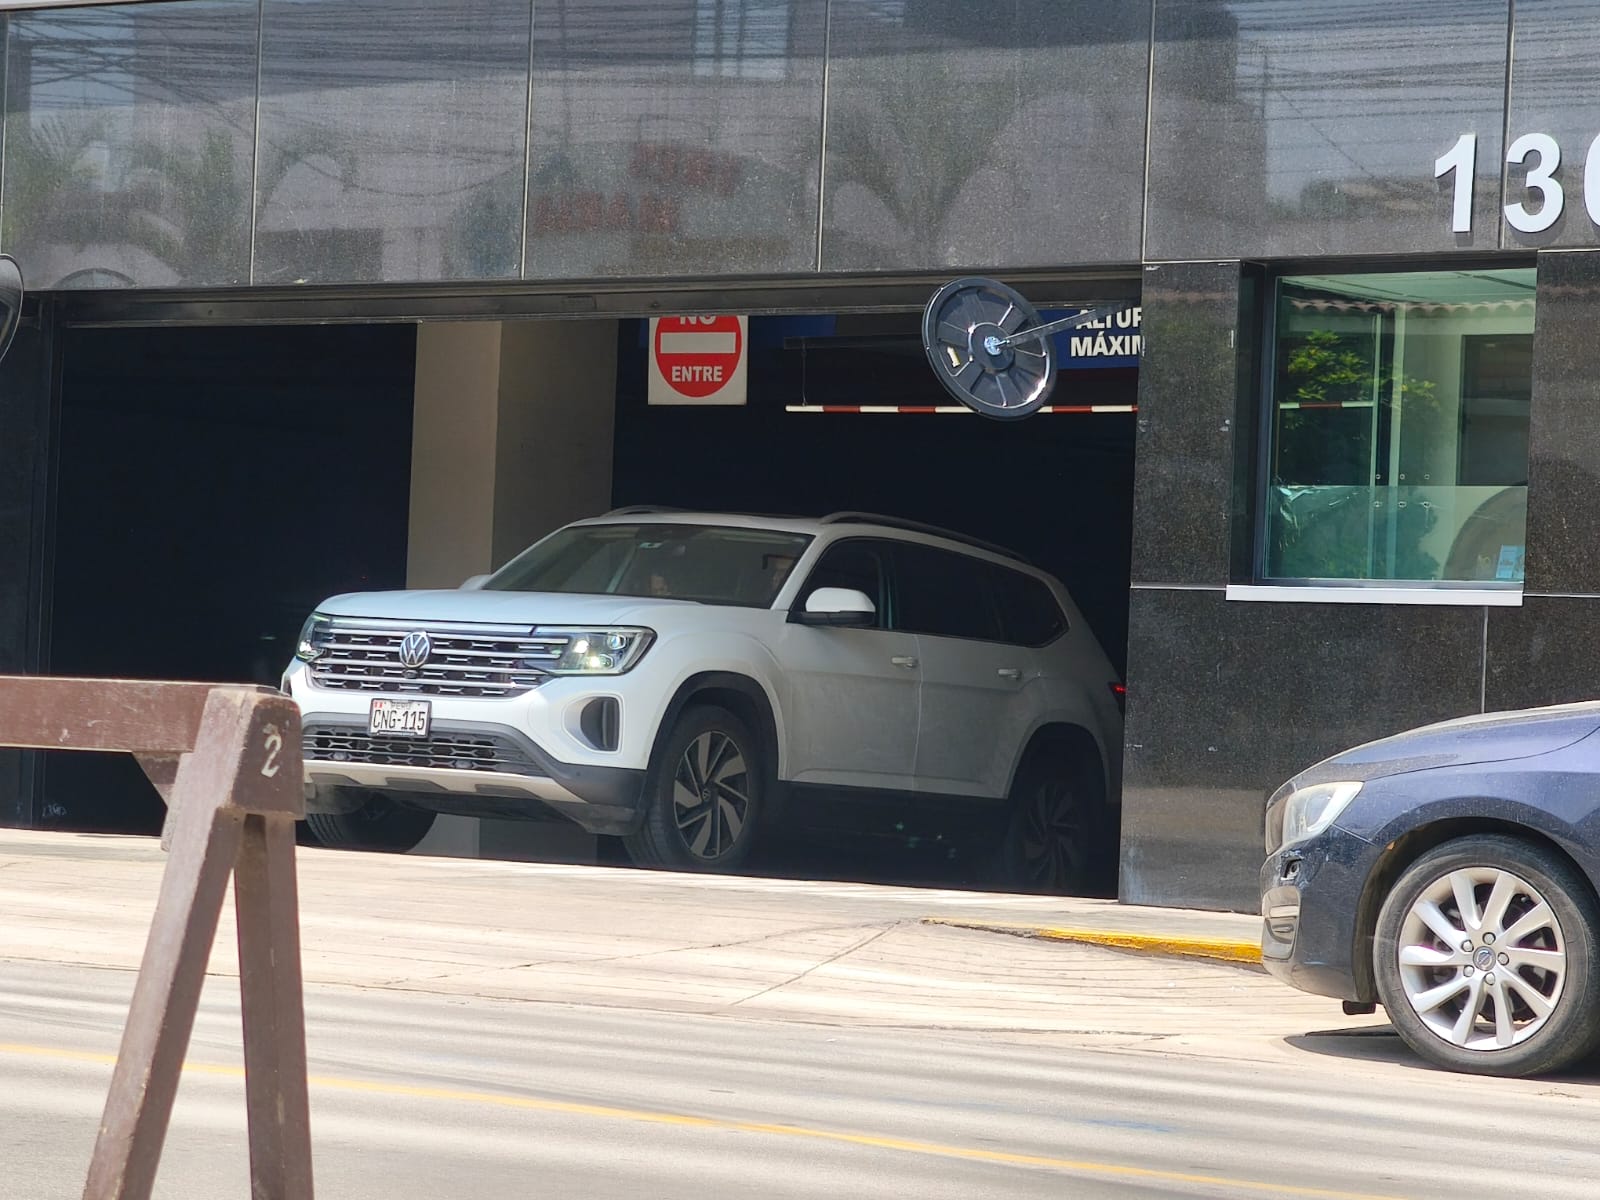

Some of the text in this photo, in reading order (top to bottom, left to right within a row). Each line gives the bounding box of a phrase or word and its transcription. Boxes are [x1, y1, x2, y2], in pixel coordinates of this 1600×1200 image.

[1435, 133, 1600, 233] 13
[672, 366, 723, 382] ENTRE
[373, 709, 426, 730] CNG-115
[261, 735, 282, 778] 2
